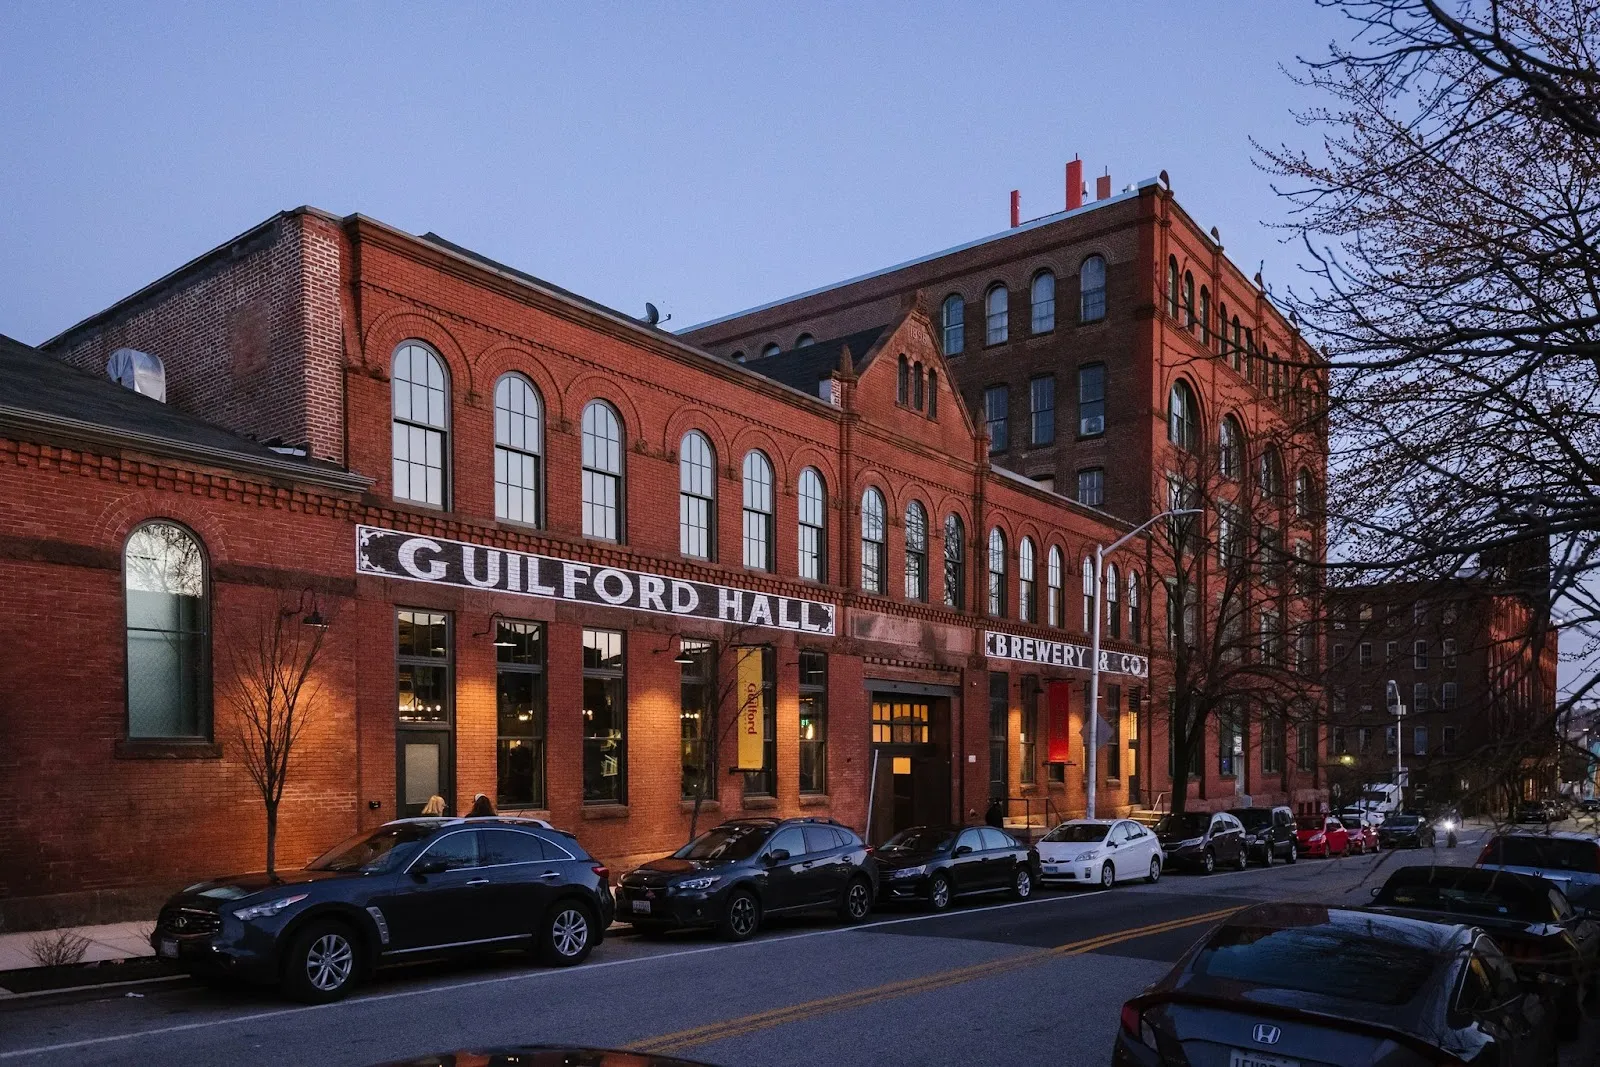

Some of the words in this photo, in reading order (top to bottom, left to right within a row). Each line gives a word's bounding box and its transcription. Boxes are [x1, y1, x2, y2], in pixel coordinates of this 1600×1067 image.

[397, 539, 699, 615] GUILFORD
[718, 588, 822, 631] HALL
[996, 634, 1085, 667] BREWERY
[1099, 652, 1109, 671] &
[747, 683, 758, 735] Guilford
